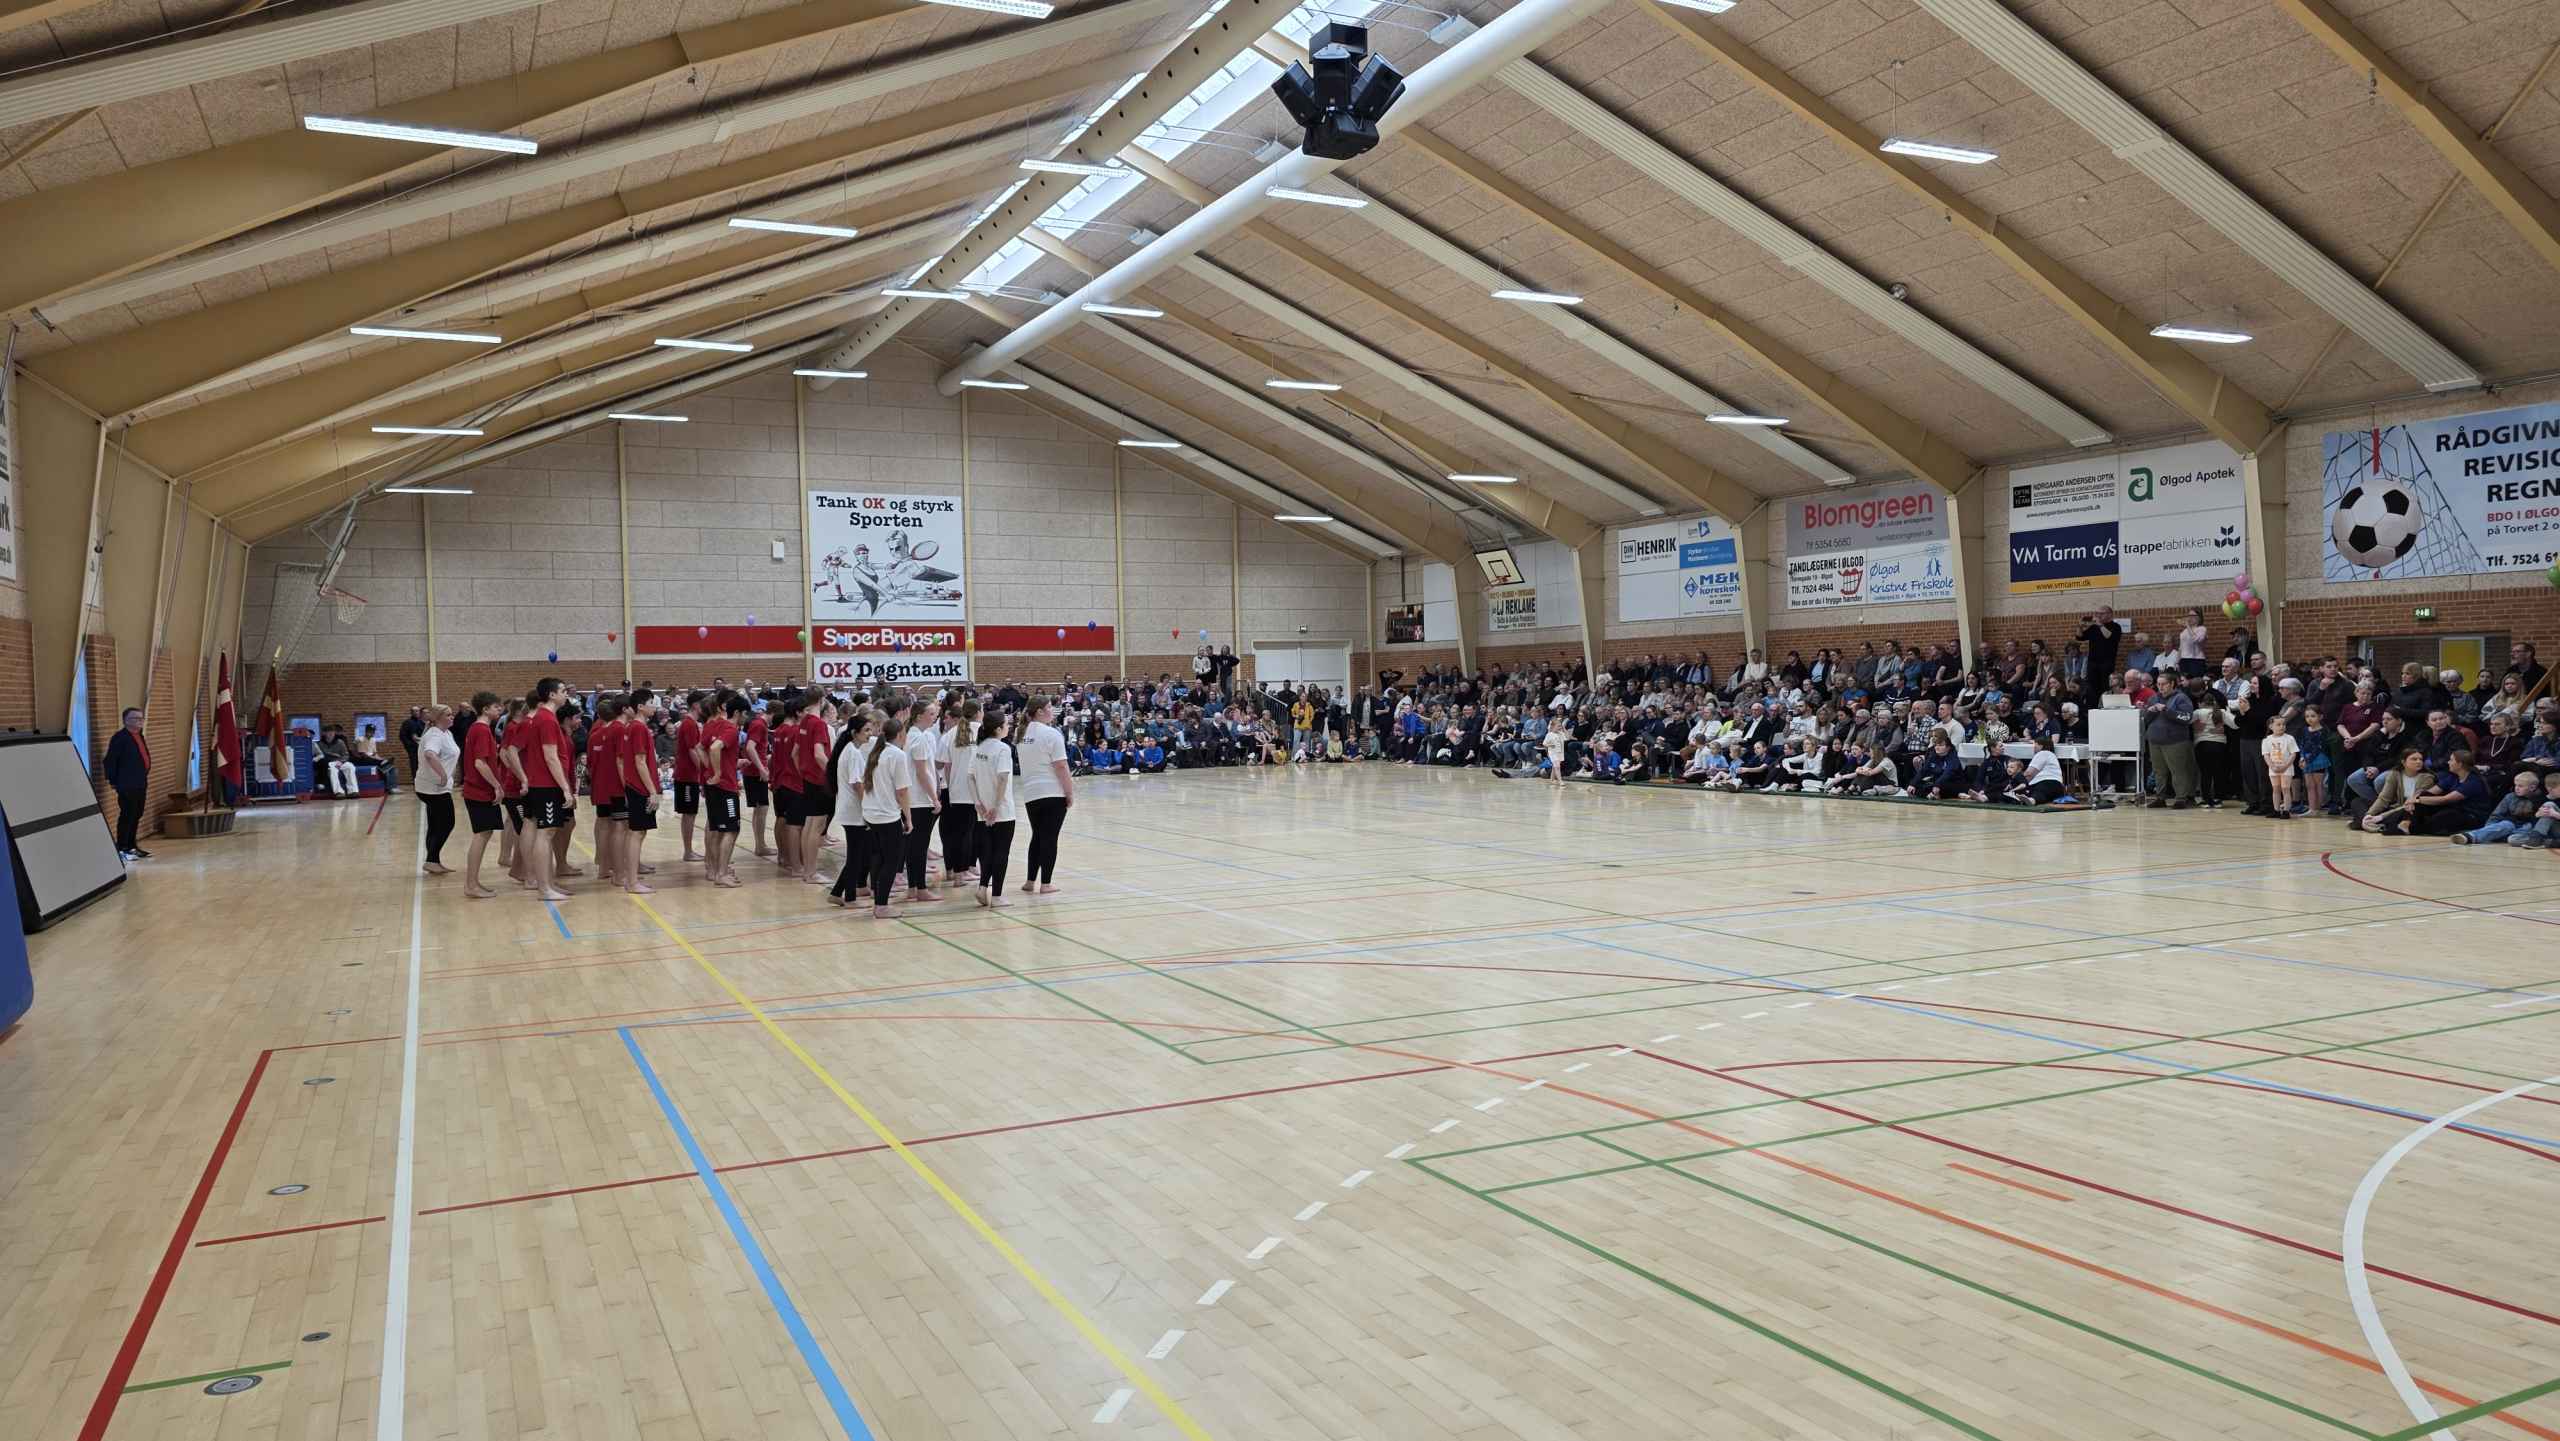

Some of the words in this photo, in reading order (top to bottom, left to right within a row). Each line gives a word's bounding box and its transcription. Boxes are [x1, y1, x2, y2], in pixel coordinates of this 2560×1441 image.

[2436, 419, 2560, 452] RÅDGIVN
[2065, 476, 2096, 486] ANDERSEN
[2097, 473, 2114, 482] OPTIK
[2160, 472, 2192, 487] Ølgod
[2196, 467, 2235, 483] Apotek
[2487, 479, 2560, 503] REGN
[816, 496, 857, 509] Tank
[862, 498, 885, 509] OK
[890, 499, 907, 513] og
[912, 499, 954, 514] styrk
[1804, 491, 1933, 529] Blomgreen
[850, 512, 924, 529] Sporten
[2487, 511, 2513, 523] BDO
[2487, 525, 2501, 537] på
[2504, 521, 2539, 534] Torvet
[2542, 521, 2549, 531] 2
[1623, 544, 1634, 554] DIN
[1637, 537, 1677, 556] HENRIK
[2012, 545, 2040, 565] VM
[2044, 544, 2087, 562] Tarm
[2093, 537, 2117, 559] a/s
[2124, 537, 2211, 555] trappefabrikken
[1789, 559, 1837, 575] TANDLÆGERNE
[1842, 556, 1864, 568] ØLGOD
[2163, 557, 2240, 570] www.trappefabrikken.dk
[2486, 556, 2508, 568] Tlf.
[2512, 553, 2540, 565] 7524
[1700, 571, 1740, 585] M&K
[1869, 561, 1900, 579] Ølgod
[1802, 585, 1817, 593] 7524
[1818, 583, 1834, 592] 4944
[1911, 576, 1954, 591] Friskole
[1505, 597, 1536, 615] REKLAME
[819, 662, 852, 678] OK
[857, 661, 962, 681] Døgntank
